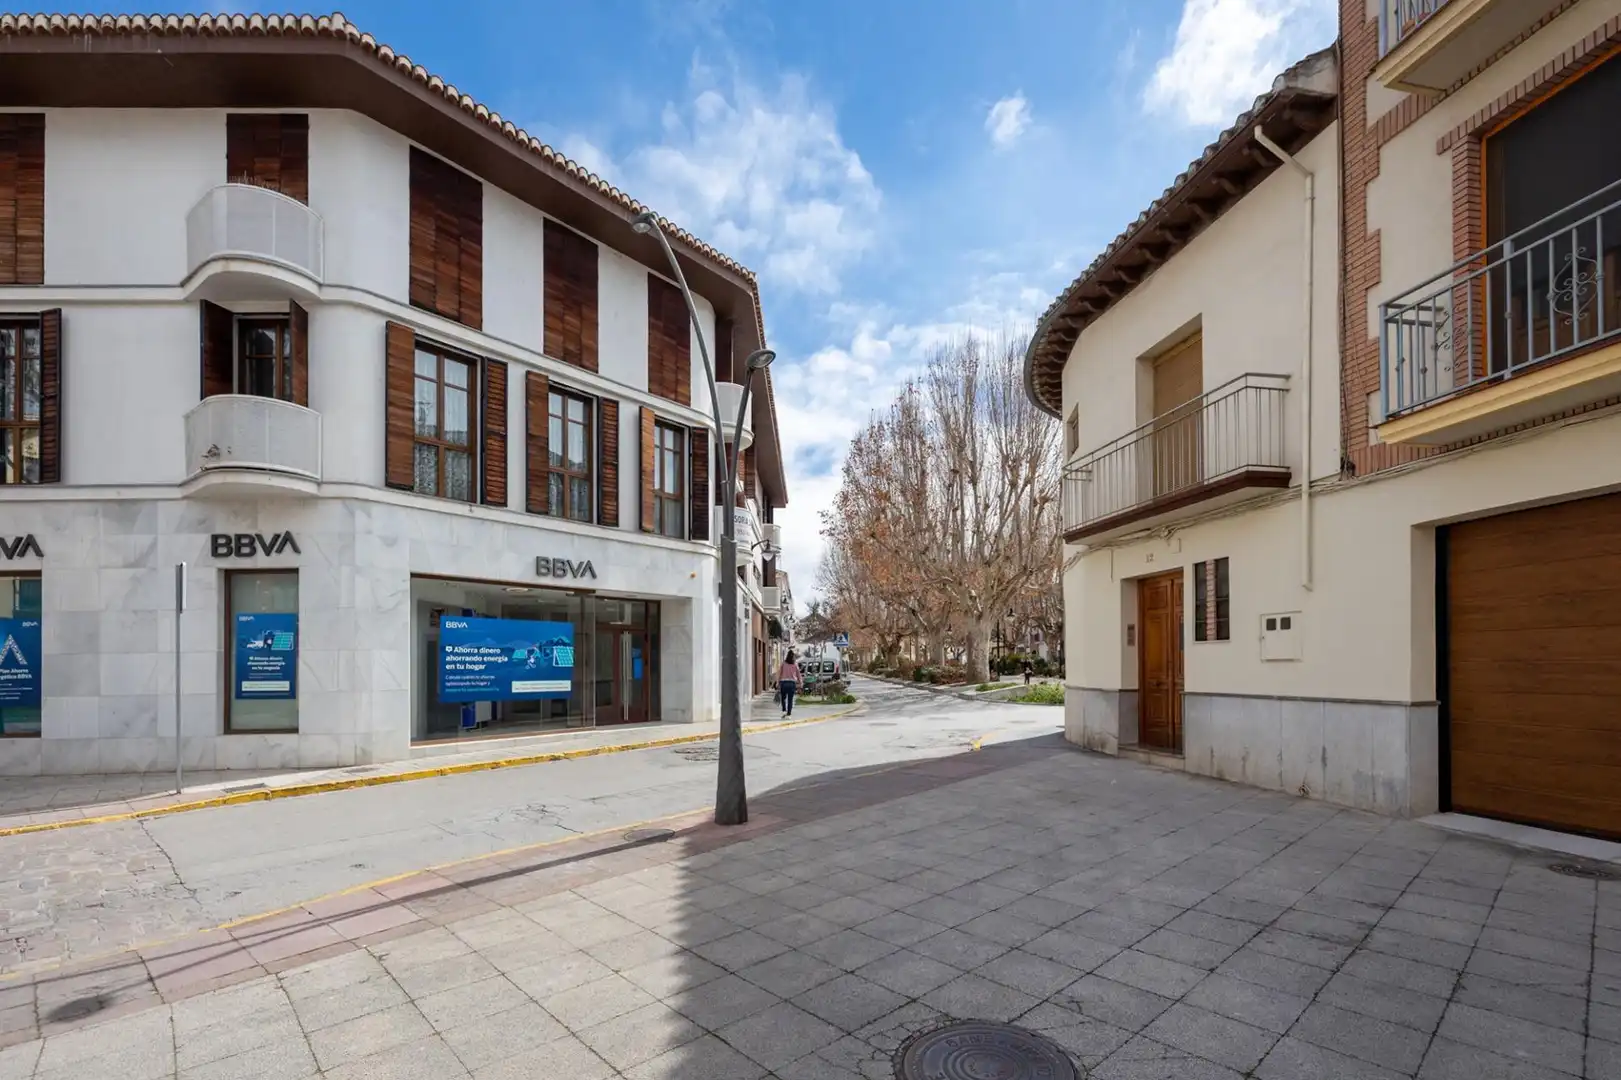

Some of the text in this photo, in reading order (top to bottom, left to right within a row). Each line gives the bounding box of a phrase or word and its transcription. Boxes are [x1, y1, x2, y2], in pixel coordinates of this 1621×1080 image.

[210, 530, 301, 558] BBVA
[535, 555, 597, 579] BBVA
[466, 663, 486, 671] hogar
[483, 655, 508, 663] energía
